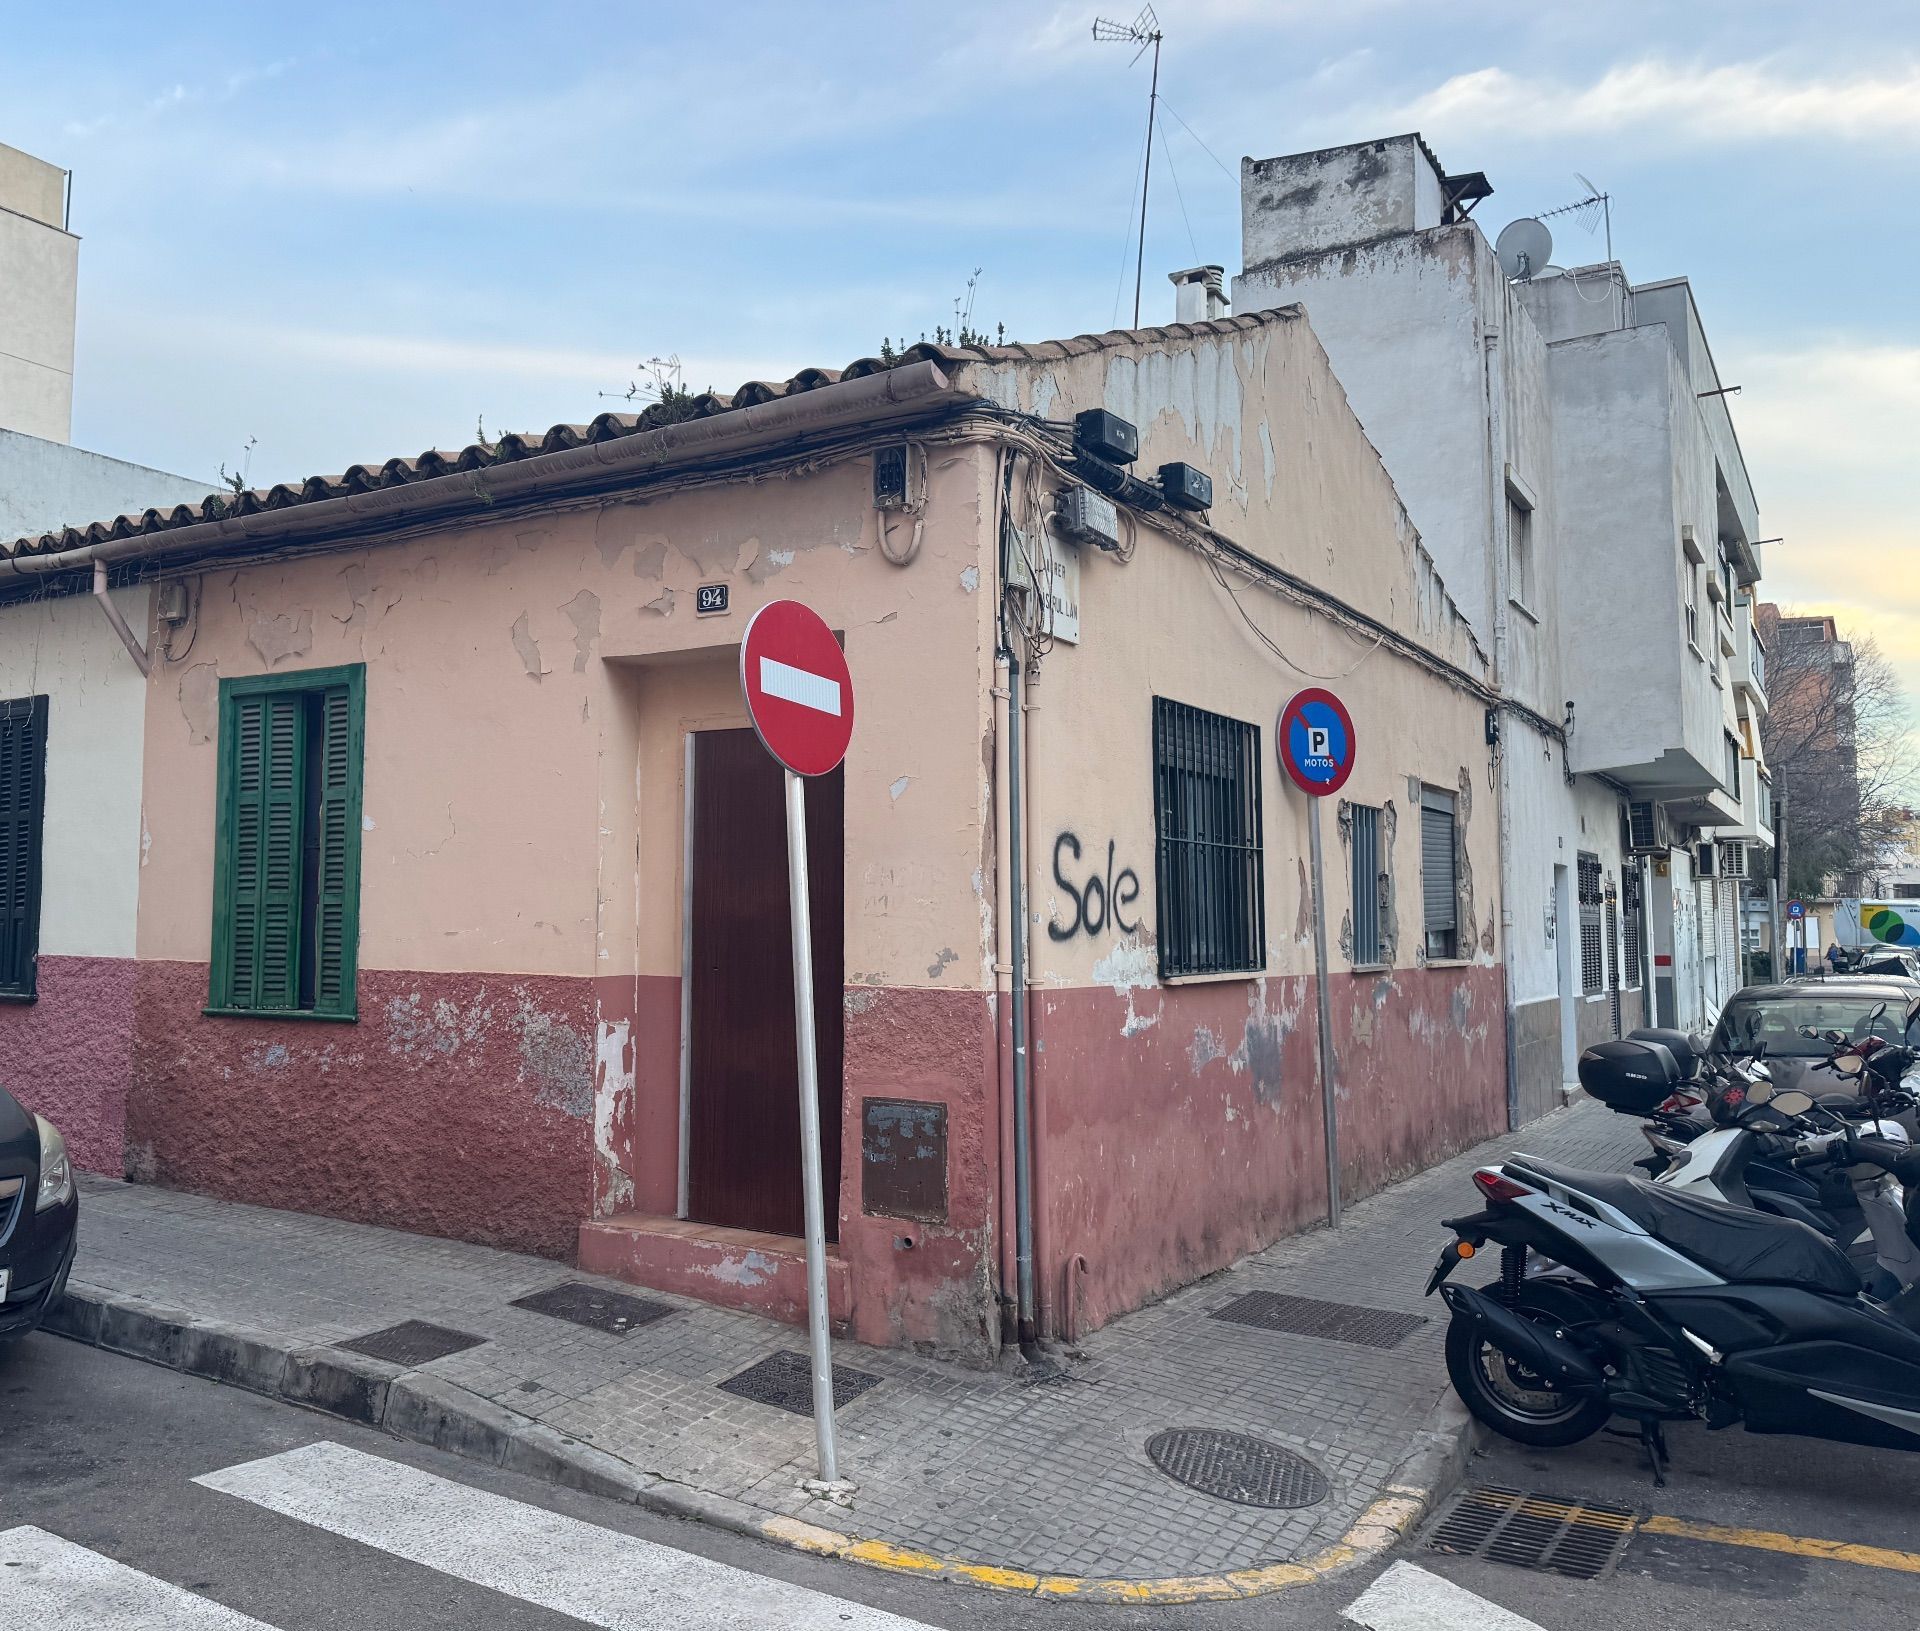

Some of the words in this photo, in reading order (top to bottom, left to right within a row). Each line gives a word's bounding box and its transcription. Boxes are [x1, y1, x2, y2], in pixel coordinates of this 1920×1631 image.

[702, 589, 722, 607] 94
[1312, 731, 1325, 753] P
[1304, 758, 1334, 768] MOTOS
[1048, 831, 1139, 943] Sole
